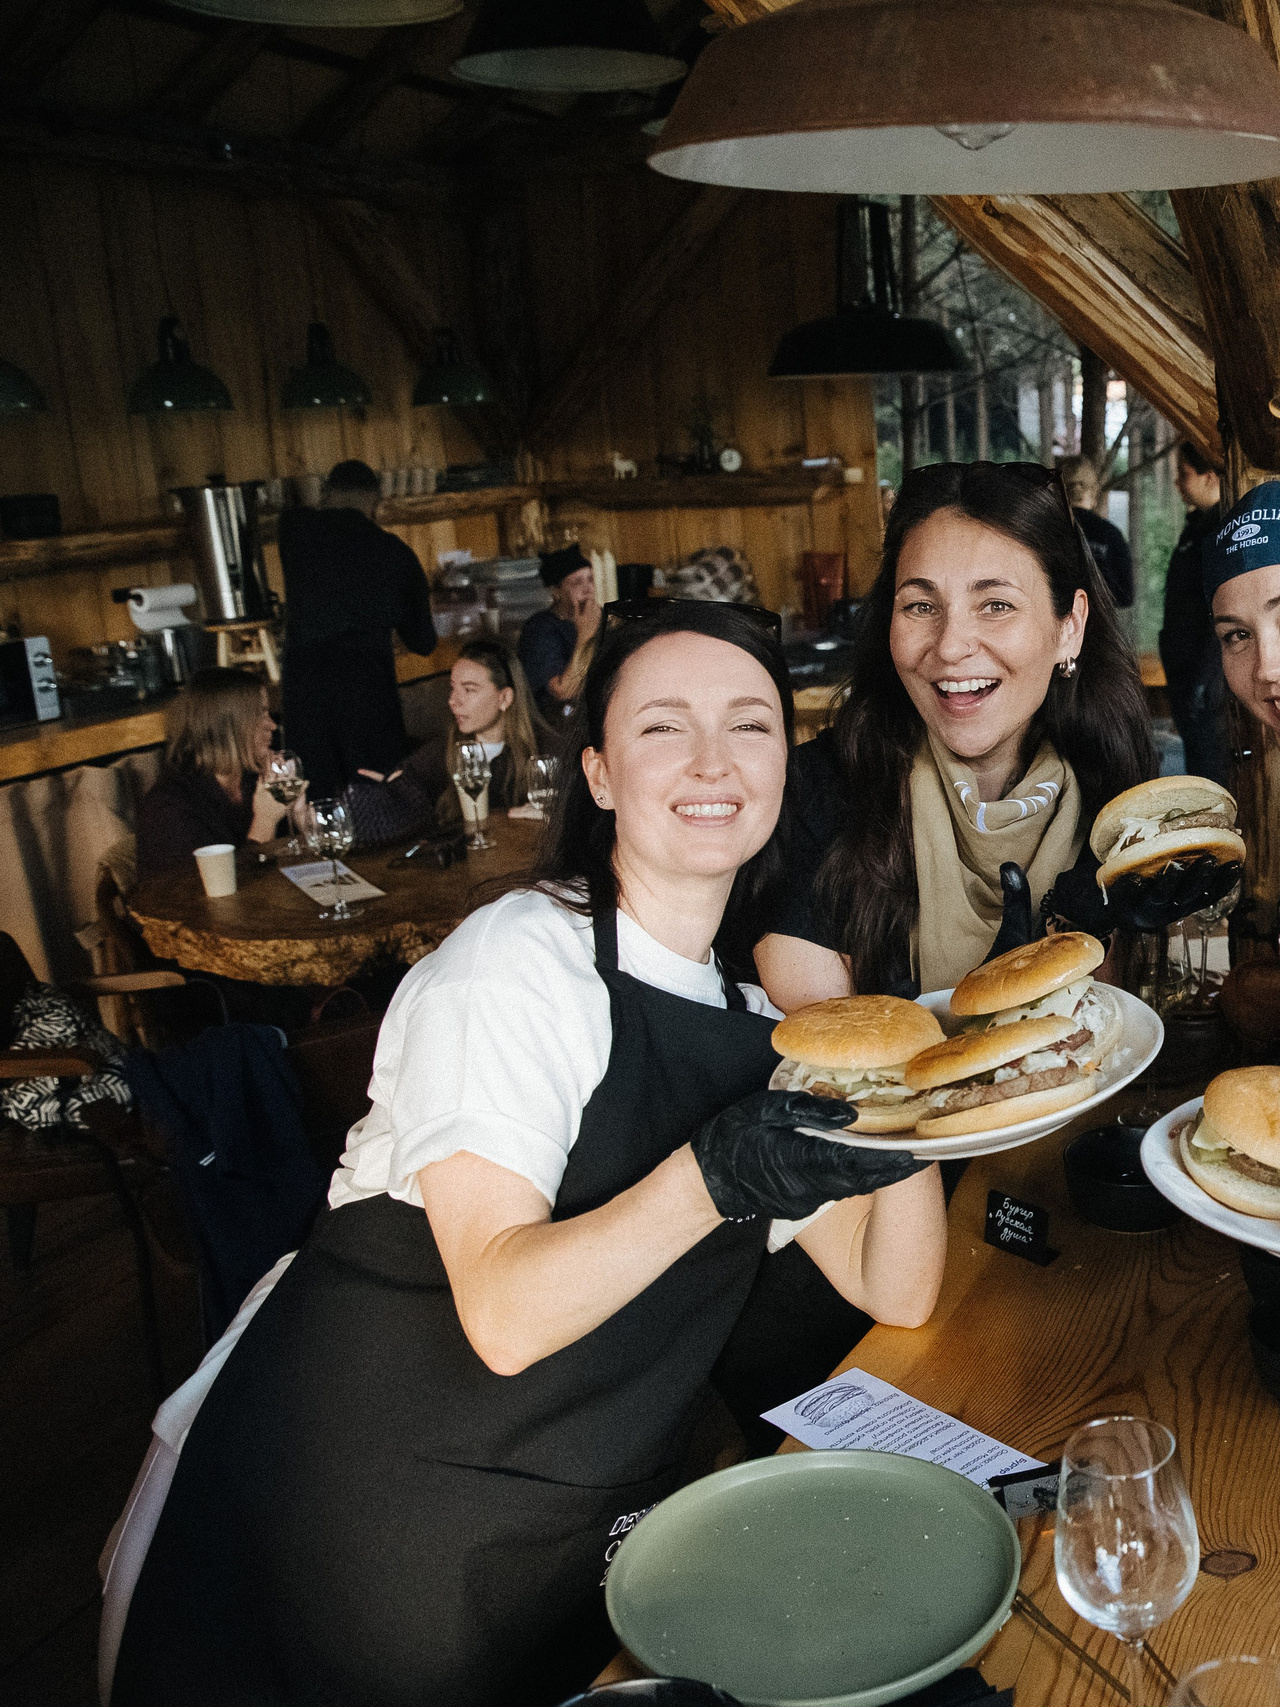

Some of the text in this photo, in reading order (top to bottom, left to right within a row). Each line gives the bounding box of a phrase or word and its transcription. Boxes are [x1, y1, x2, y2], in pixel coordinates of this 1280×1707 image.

[1237, 527, 1254, 538] 1991
[1225, 543, 1239, 555] THE
[998, 1457, 1027, 1474] Бургер
